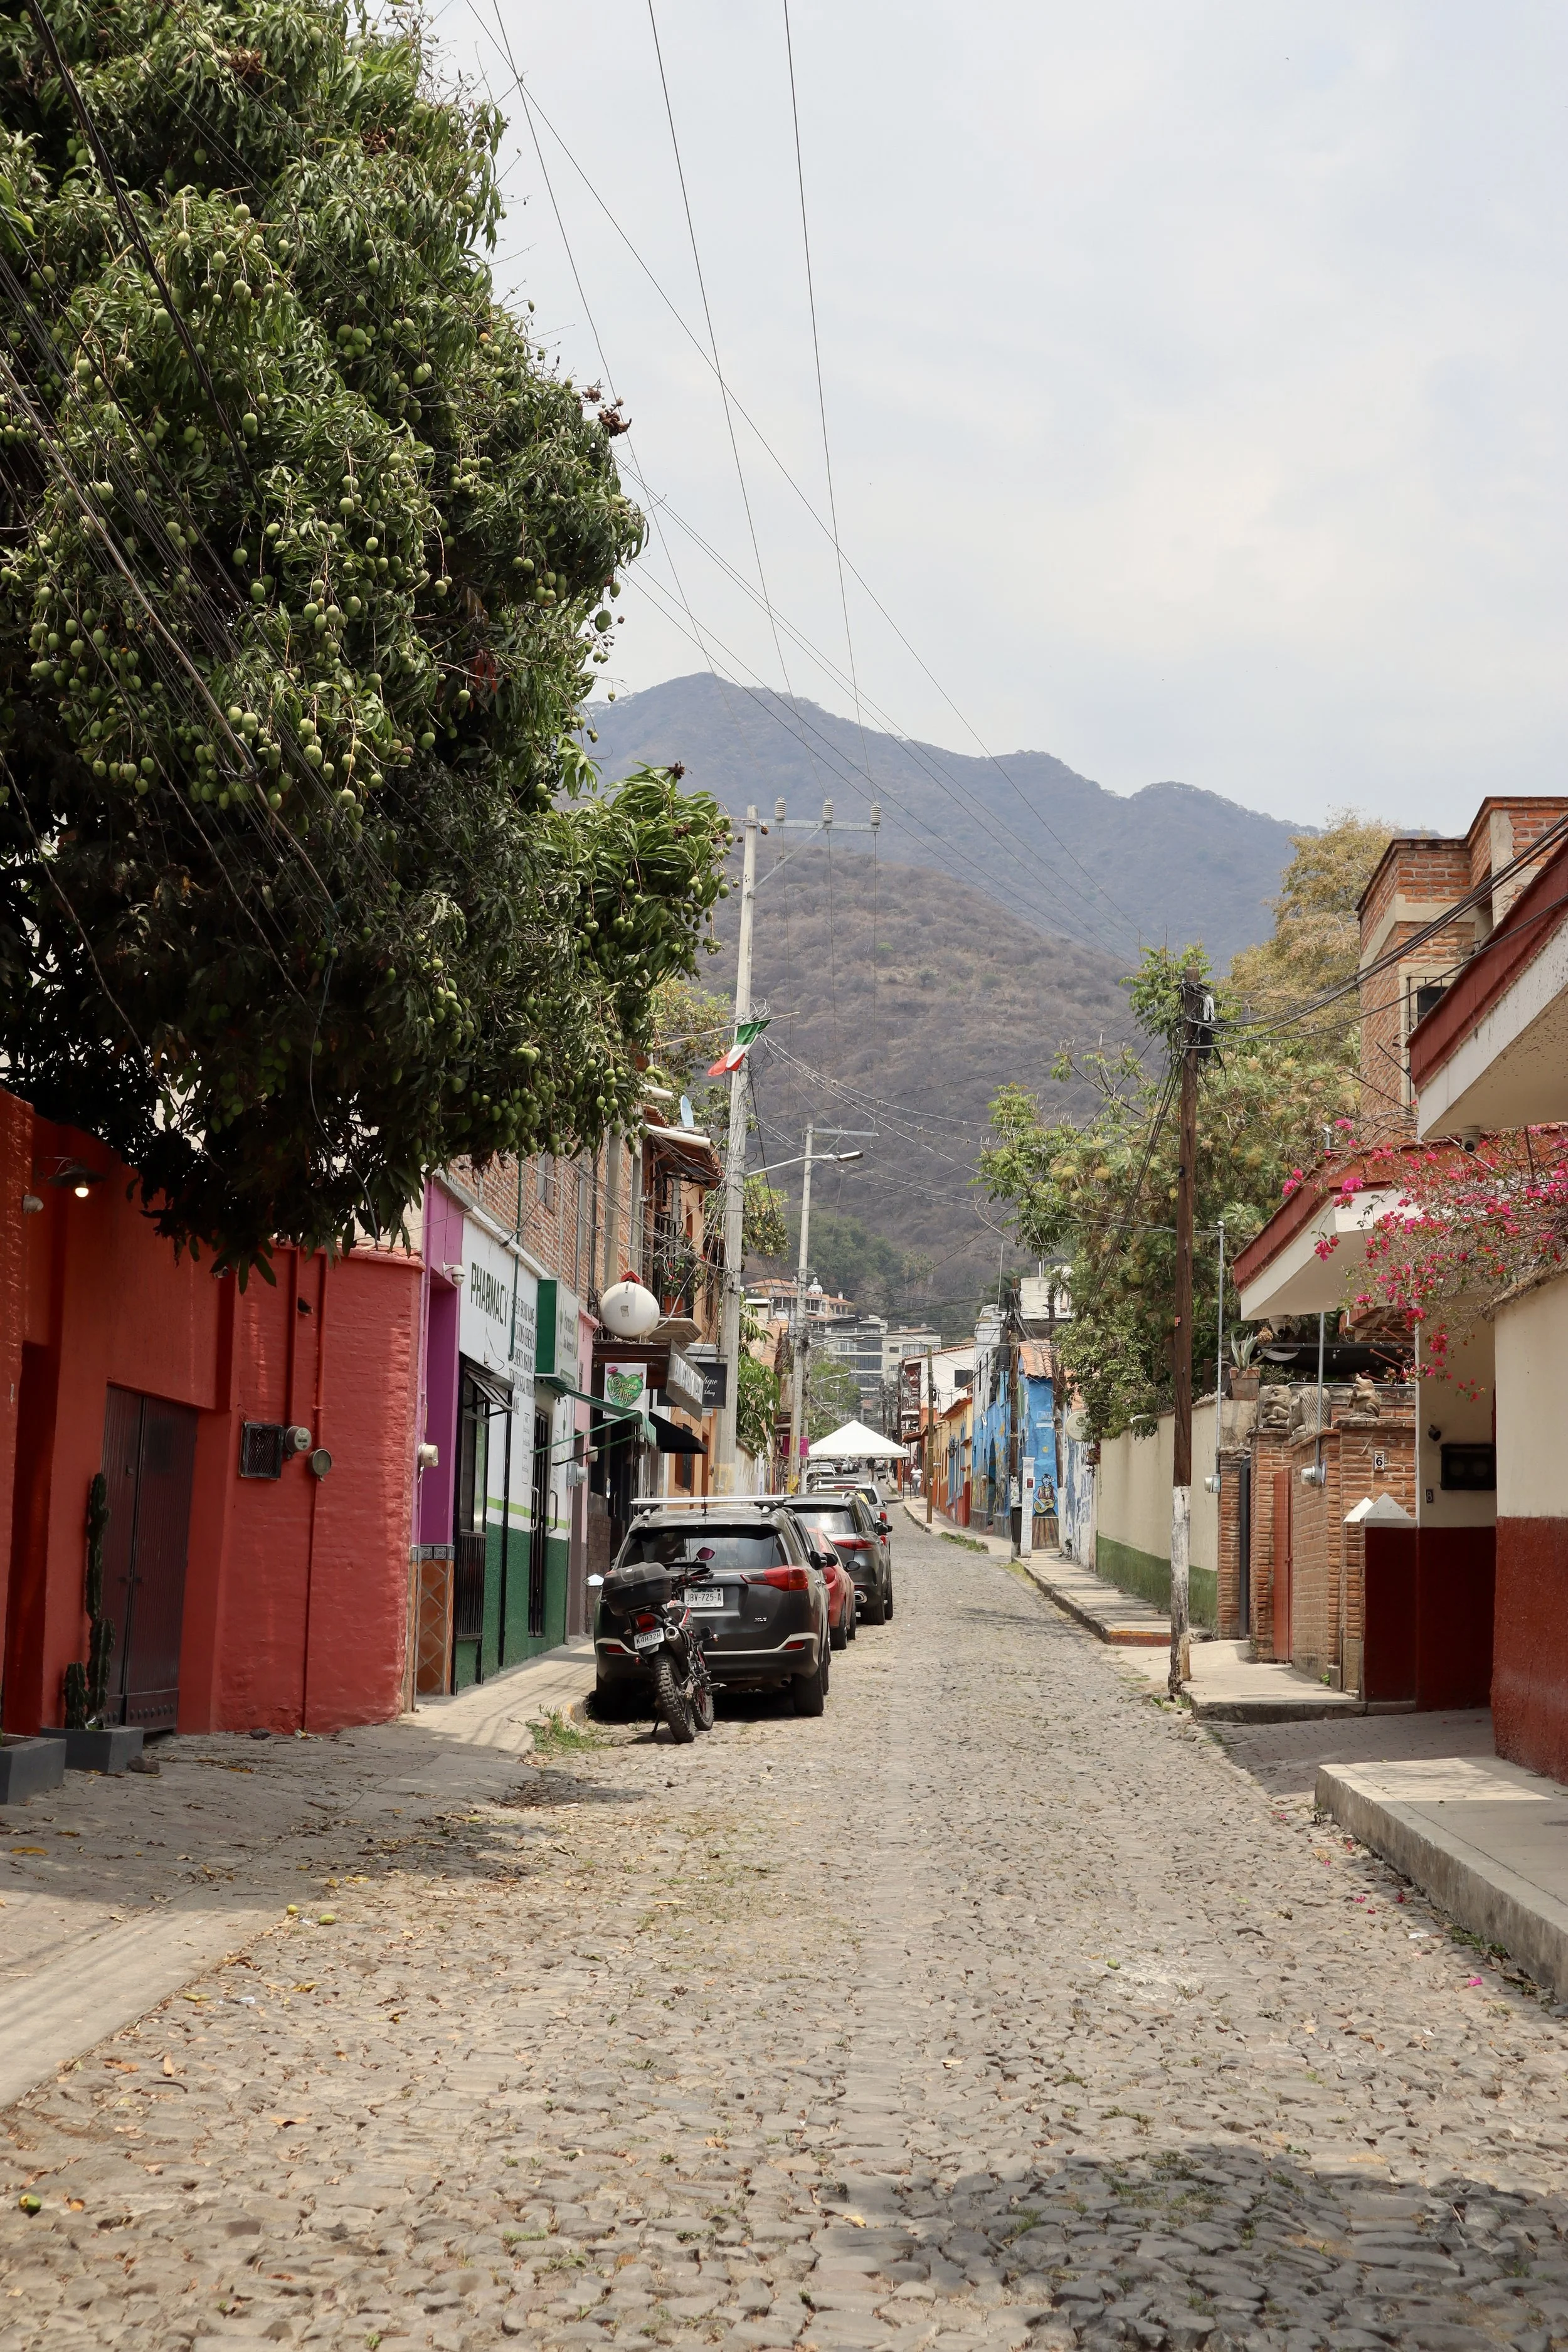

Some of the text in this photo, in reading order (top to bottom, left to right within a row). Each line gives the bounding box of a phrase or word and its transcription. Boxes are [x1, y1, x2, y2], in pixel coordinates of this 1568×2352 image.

[470, 1262, 509, 1327] PHARMACY
[1376, 1457, 1382, 1466] 6
[1427, 1491, 1432, 1502] 8
[686, 1592, 721, 1602] JBV-725-A
[637, 1632, 661, 1644] K4H32H
